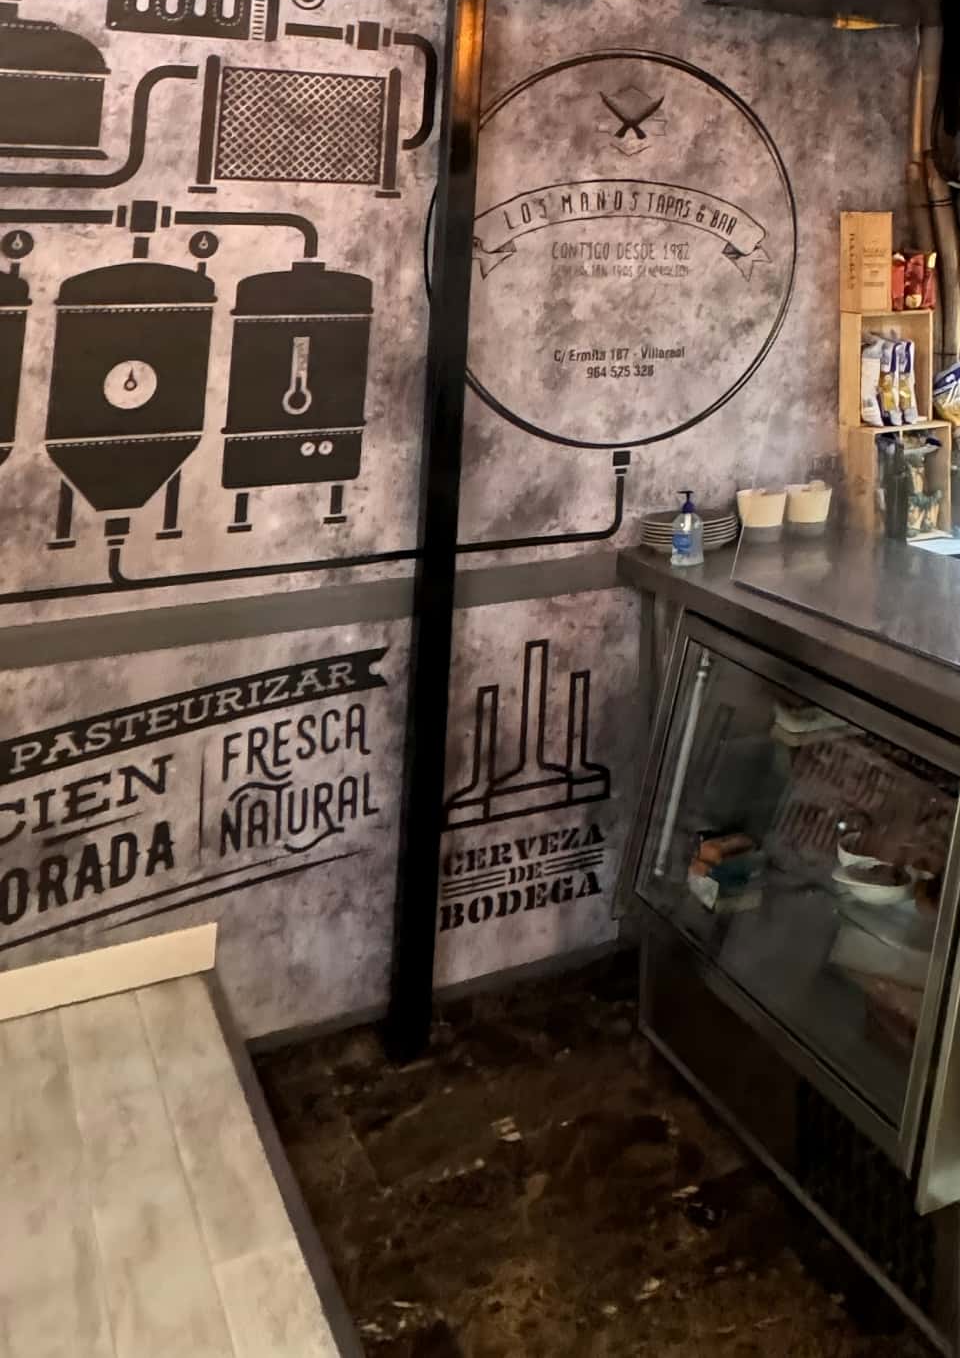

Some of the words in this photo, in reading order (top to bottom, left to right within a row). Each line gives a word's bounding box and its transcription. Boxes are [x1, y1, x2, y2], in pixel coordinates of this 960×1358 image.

[503, 197, 548, 230] LOS
[647, 192, 692, 219] TAPAS
[709, 209, 738, 235] BAR
[551, 241, 610, 260] CONTIGO
[616, 241, 656, 260] DESDE
[553, 348, 567, 363] C/
[586, 365, 607, 379] 964
[609, 364, 631, 379] 525
[10, 660, 356, 774] PASTEURIZAR
[221, 702, 372, 783] FRESCA
[219, 772, 381, 858] NATURAL
[443, 823, 606, 876] CERVEZA
[508, 861, 543, 885] DE
[439, 871, 603, 933] BODEGA
